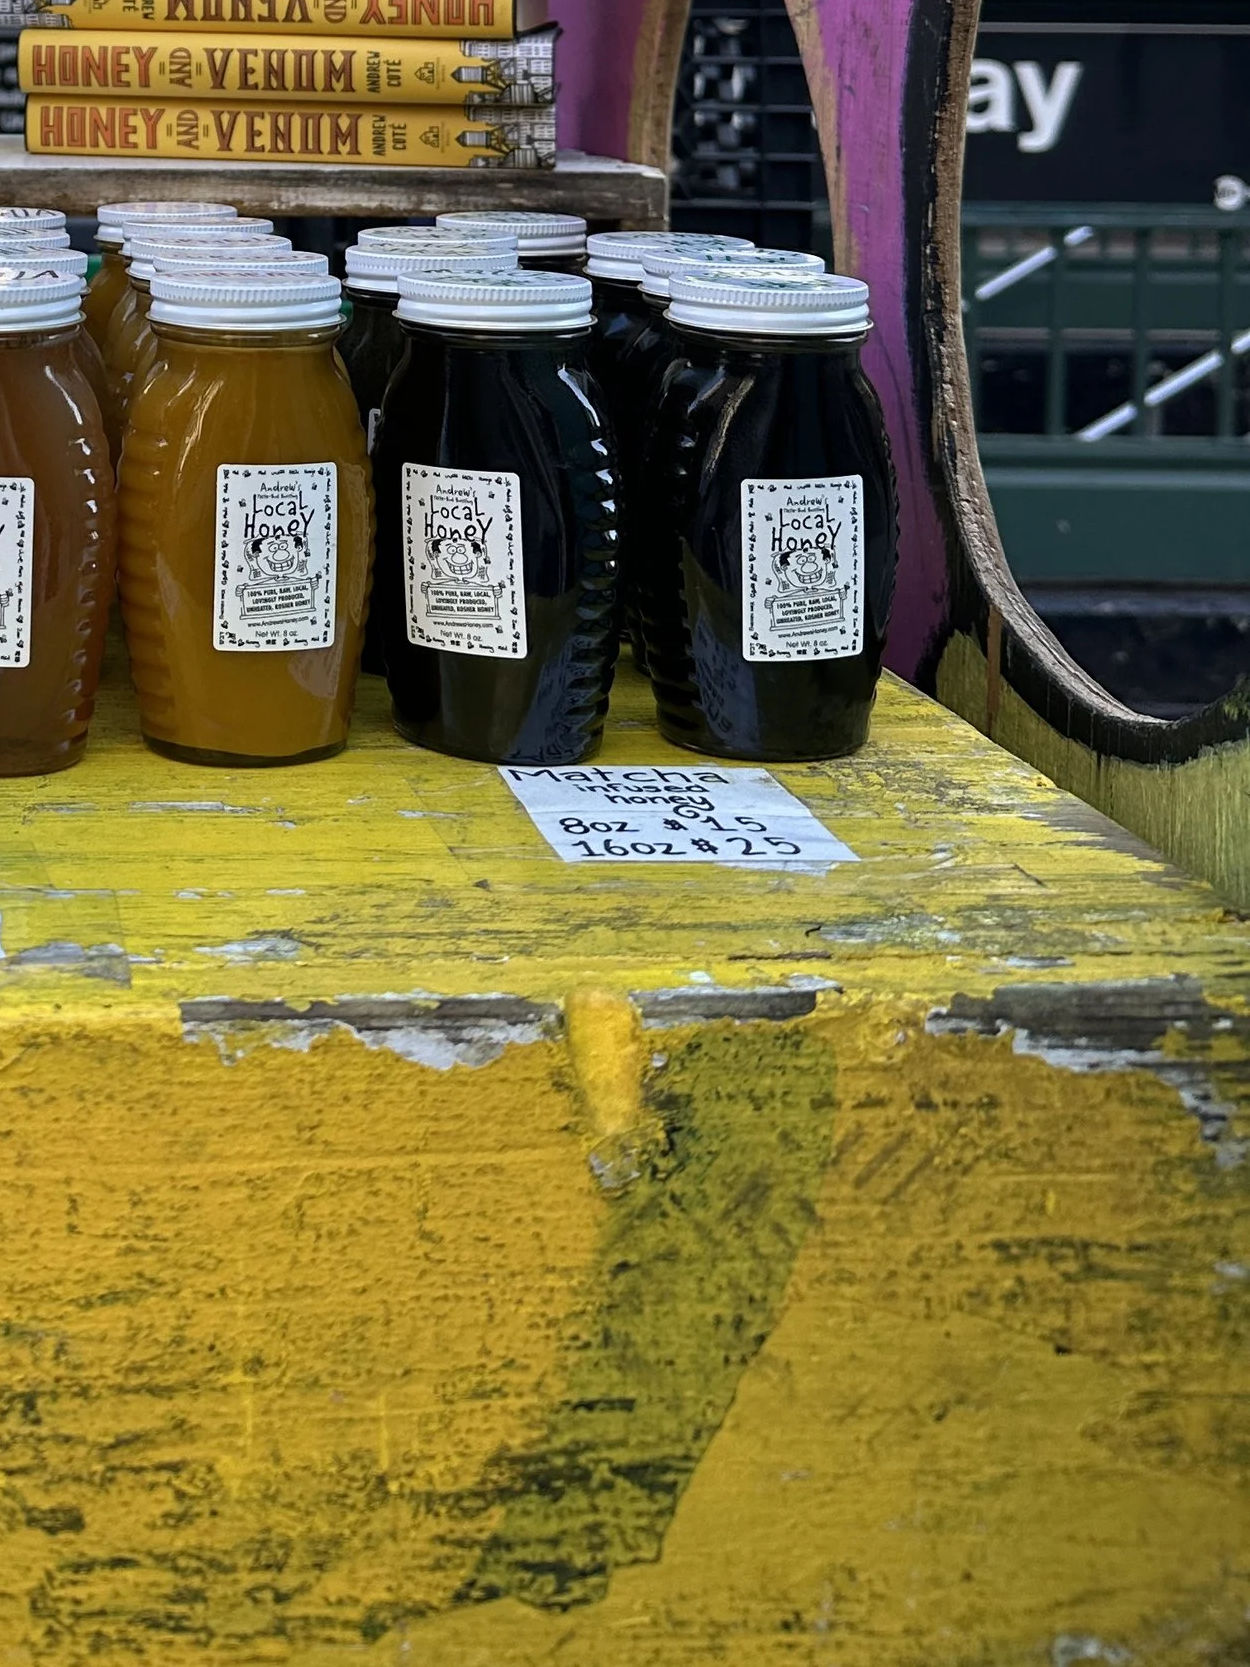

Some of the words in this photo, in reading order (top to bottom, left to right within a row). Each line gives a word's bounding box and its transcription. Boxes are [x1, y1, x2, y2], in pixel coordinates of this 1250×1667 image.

[32, 45, 157, 89] HONEY
[169, 48, 194, 89] AND
[203, 49, 356, 92] VENOM
[367, 52, 380, 93] ANDREW
[384, 60, 402, 88] COTÉ
[42, 106, 165, 149] HONEY
[176, 109, 200, 150] AND
[210, 111, 362, 155] VENOM
[373, 114, 385, 156] ANDREW
[390, 124, 406, 150] COTÉ
[261, 481, 301, 492] Andrew's
[436, 485, 476, 497] Andrew's
[787, 495, 828, 506] Andrew's
[507, 768, 730, 784] Matcha
[559, 817, 640, 835] 8oz
[571, 839, 688, 858] 16oz
